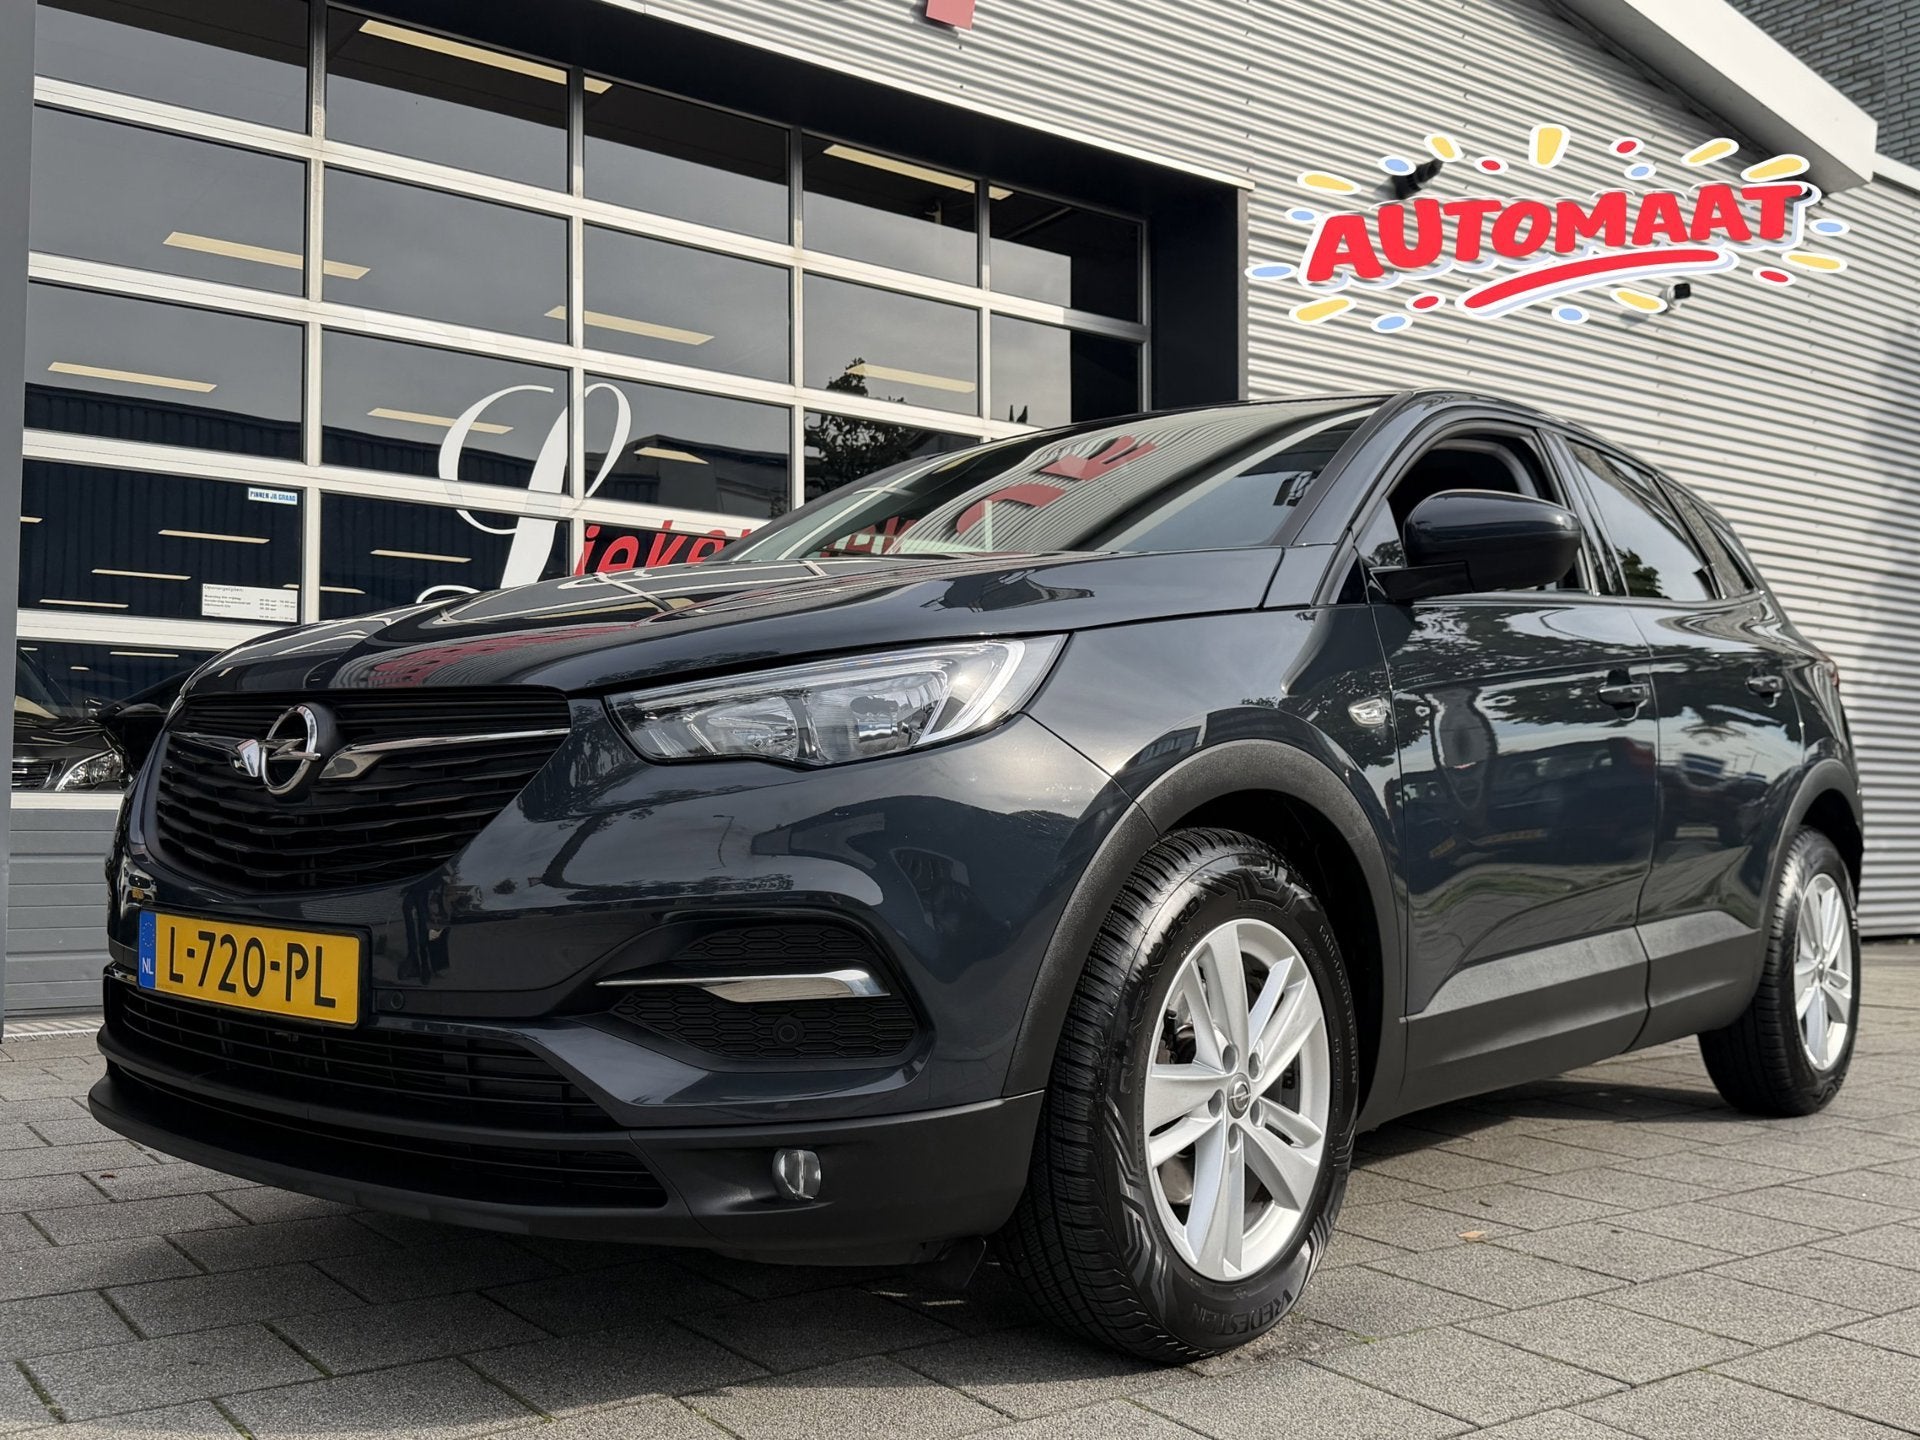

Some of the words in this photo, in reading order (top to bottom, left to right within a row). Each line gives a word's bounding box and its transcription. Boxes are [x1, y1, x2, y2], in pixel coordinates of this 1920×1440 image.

[141, 956, 154, 975] NL
[168, 926, 336, 1009] L-720-PL
[1192, 1287, 1294, 1336] VREDESTEIN
